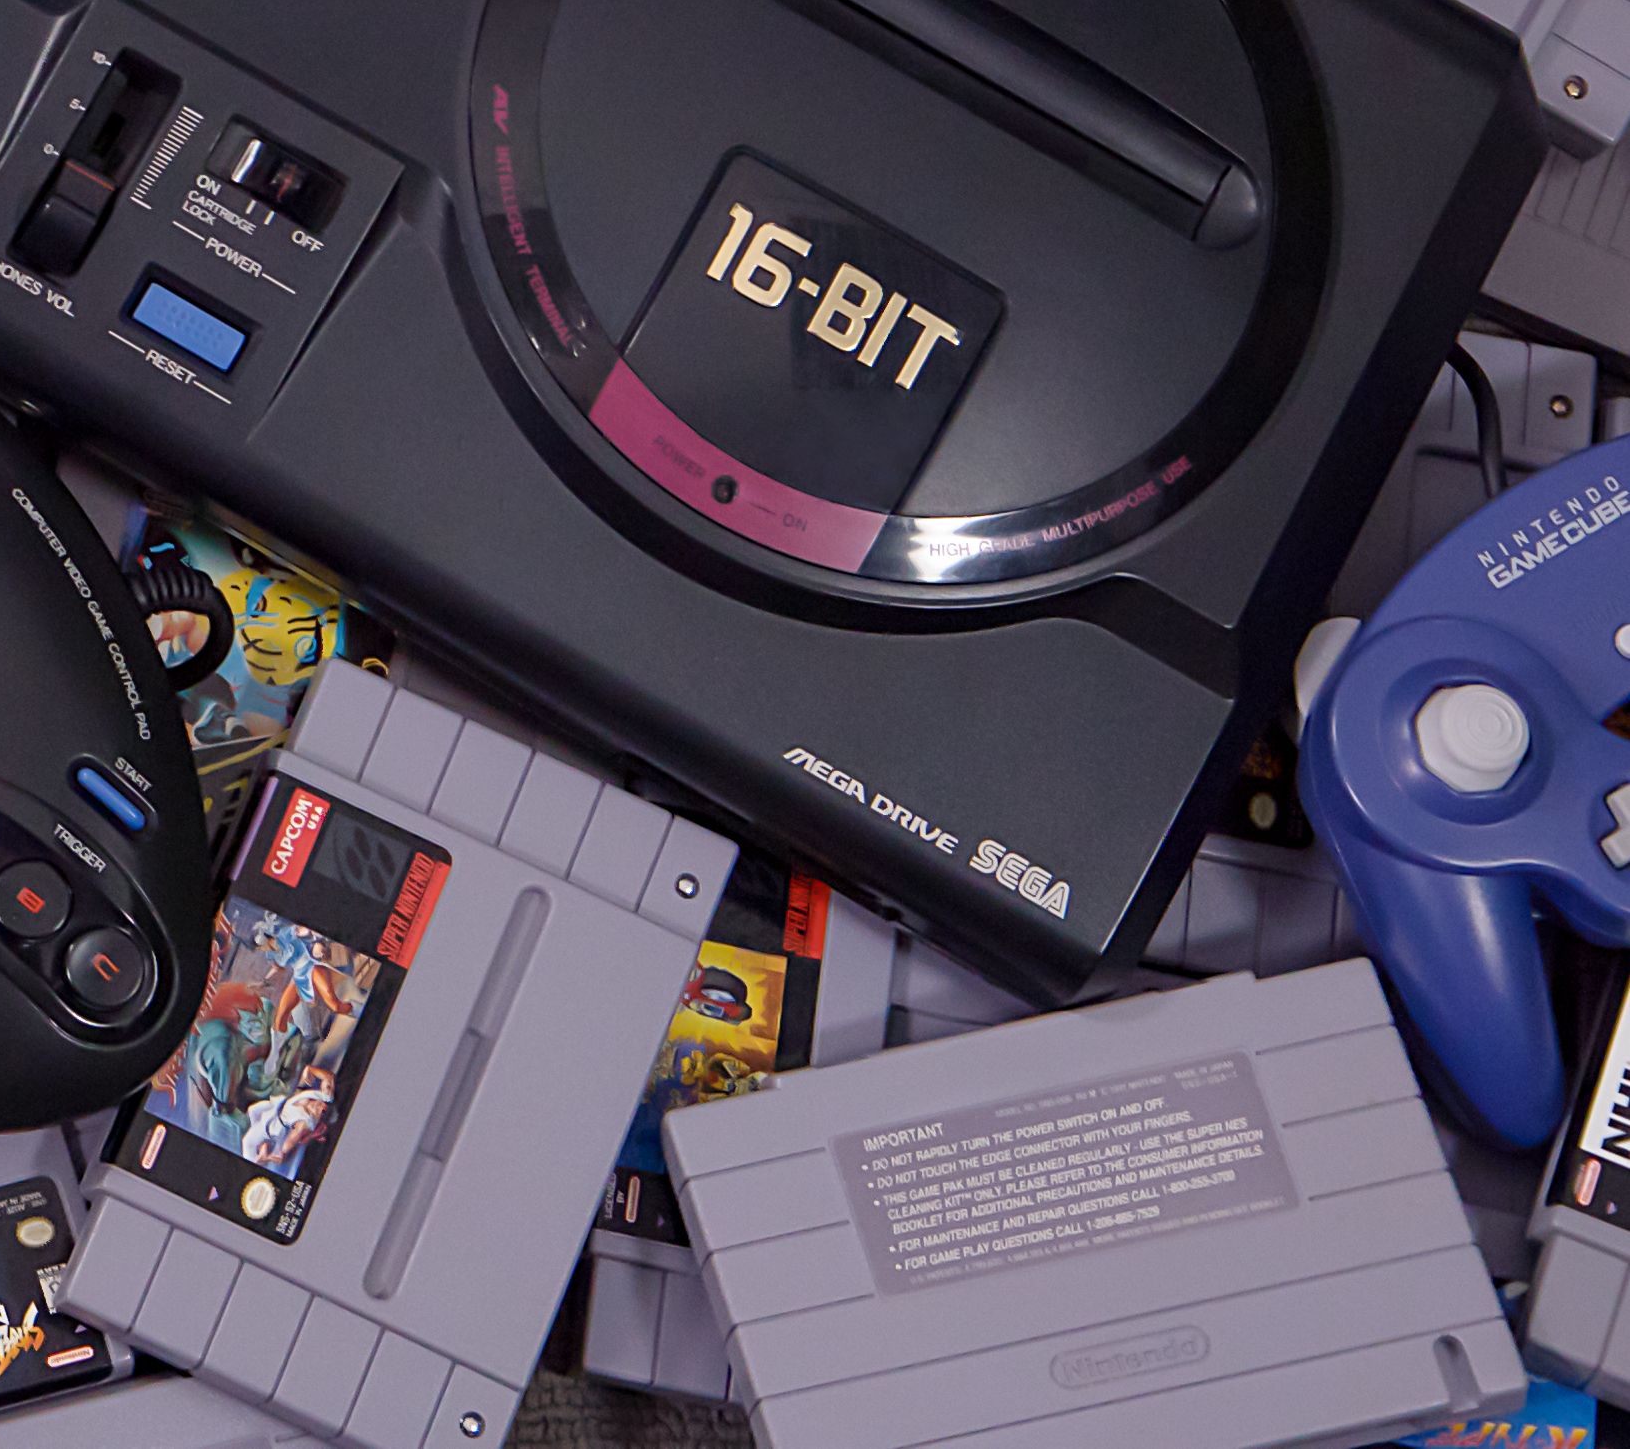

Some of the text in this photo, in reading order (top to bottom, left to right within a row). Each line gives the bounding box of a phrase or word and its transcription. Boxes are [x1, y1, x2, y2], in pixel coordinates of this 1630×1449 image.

[196, 174, 220, 195] ON
[205, 237, 261, 277] POWER
[291, 230, 322, 253] OFF
[45, 287, 75, 318] VOL
[707, 202, 960, 389] 16-BIT
[145, 349, 195, 384] RESET
[928, 542, 968, 557] HIGH
[1041, 485, 1159, 542] MULTIPURPOSE
[1161, 457, 1193, 485] USE
[12, 488, 151, 740] COMPUTER VIDEO GAME CONTROL PAD
[271, 795, 311, 873] CAPCOM
[784, 747, 1071, 919] MEGA DRIVE SEGA
